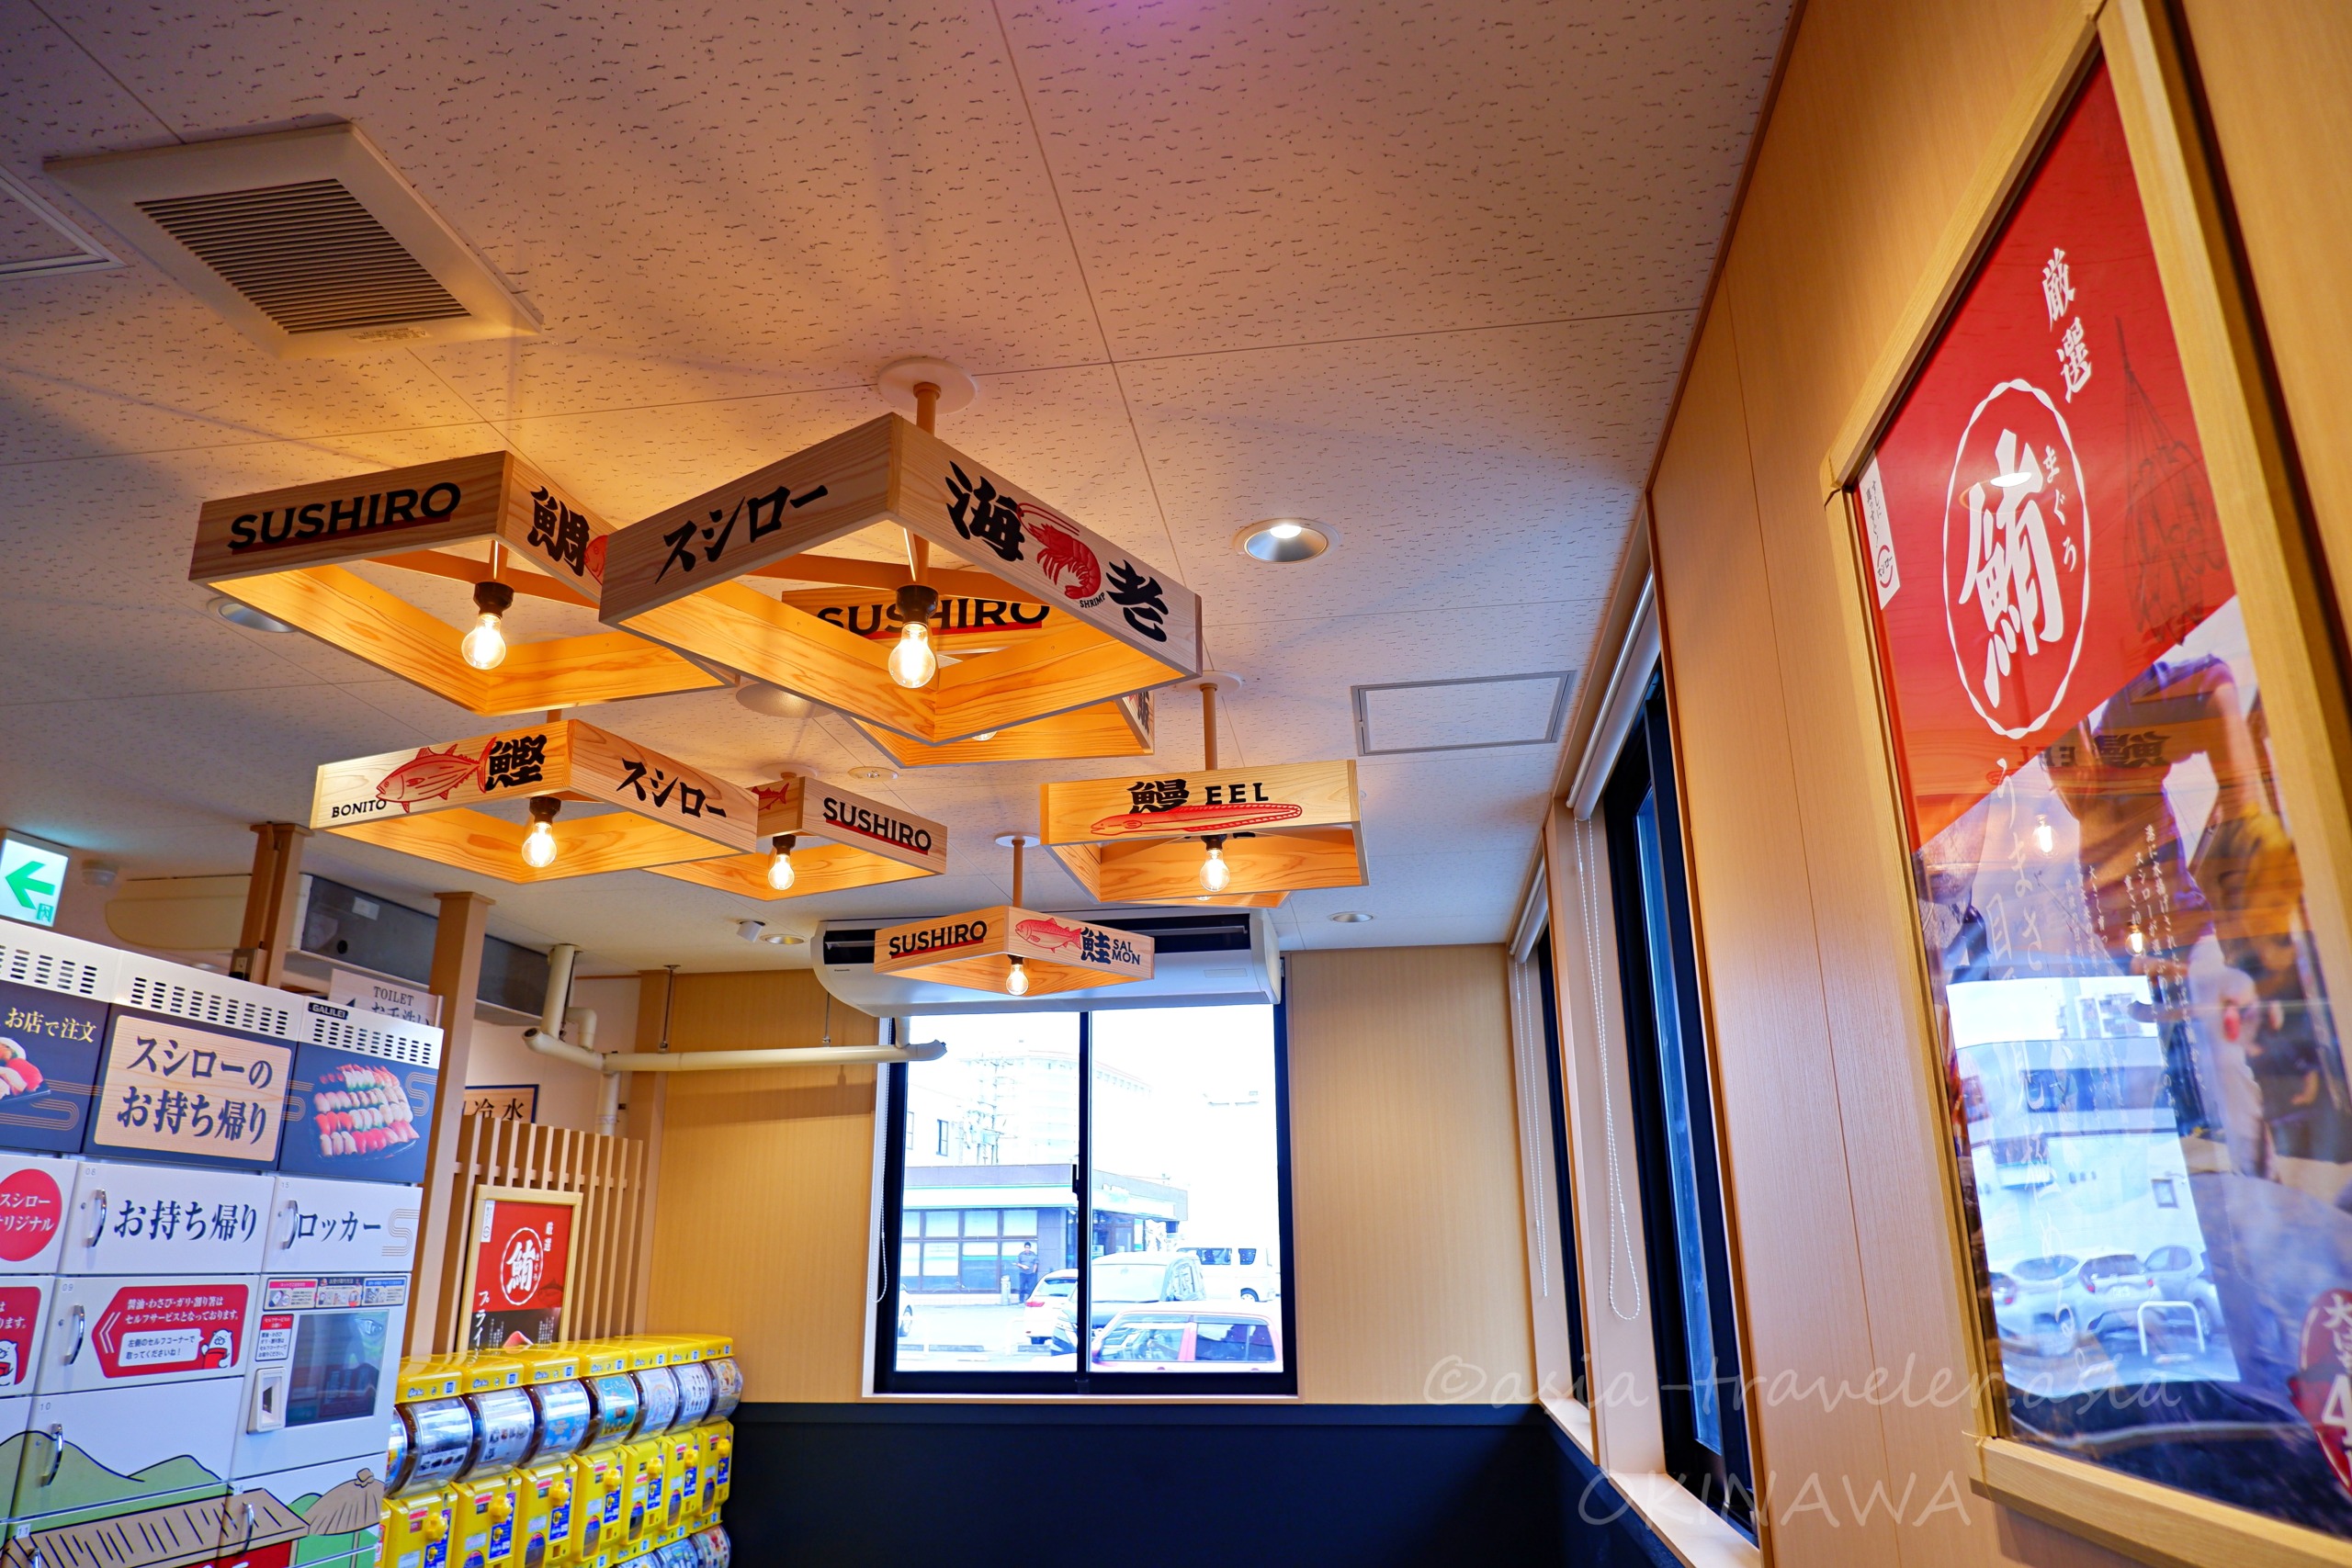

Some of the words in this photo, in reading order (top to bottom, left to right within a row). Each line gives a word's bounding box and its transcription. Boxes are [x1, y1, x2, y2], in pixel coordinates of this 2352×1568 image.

[2042, 248, 2091, 403] 厳選
[227, 481, 461, 551] SUSHIRO
[2043, 445, 2078, 571] まぐろ
[527, 485, 590, 577] 鯛
[654, 484, 829, 585] スシロー
[1958, 428, 2064, 707] 鮪
[1080, 592, 1105, 608] SHRIMP
[616, 757, 728, 818] スシロー
[1126, 779, 1190, 814] 鰻
[1204, 783, 1269, 805] EEL
[332, 797, 388, 818] BONITO
[822, 797, 933, 852] SUSHIRO
[888, 919, 988, 957] SUSHIRO
[1080, 927, 1112, 965] 鮭
[1111, 949, 1141, 965] MON
[1112, 938, 1134, 953] SAL
[311, 1004, 345, 1019] GALILEI
[373, 986, 414, 1007] TOILET
[4, 1007, 97, 1043] お店で注文
[127, 1035, 274, 1089] スシローの
[117, 1086, 267, 1145] お持ち帰り
[0, 1192, 51, 1209] スシロー
[114, 1199, 258, 1243] お持ち帰り
[297, 1210, 382, 1243] ロッカー
